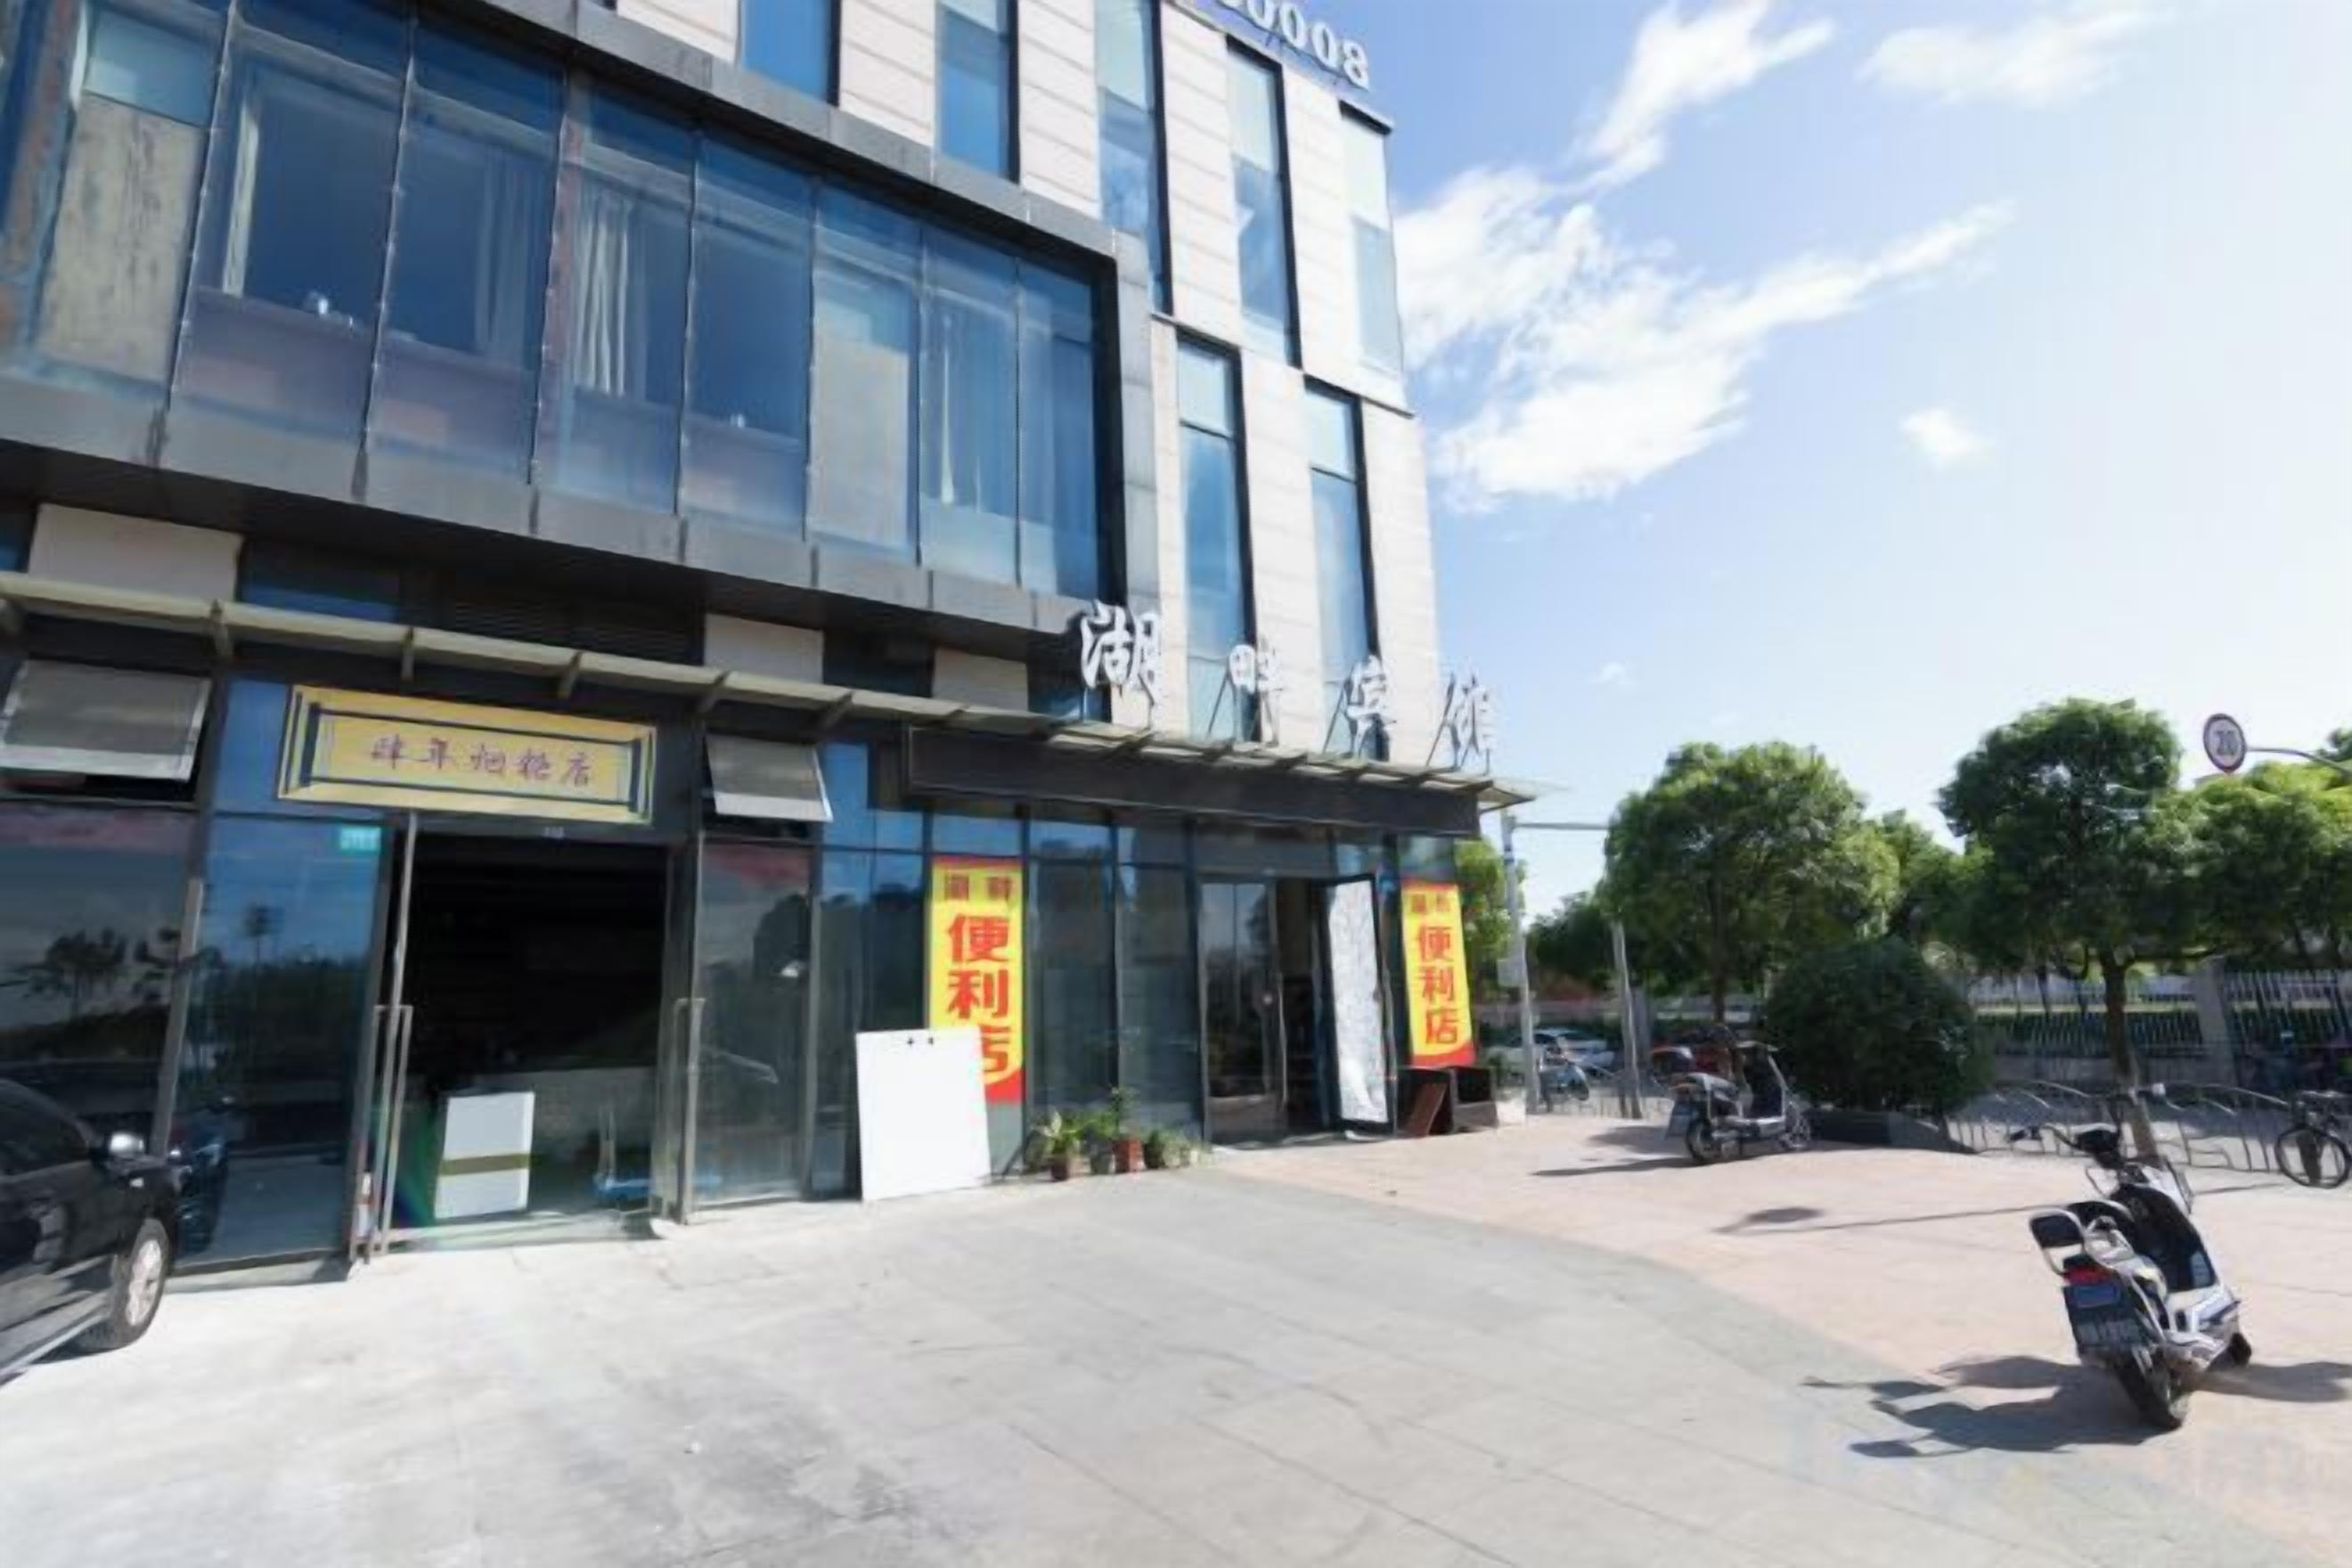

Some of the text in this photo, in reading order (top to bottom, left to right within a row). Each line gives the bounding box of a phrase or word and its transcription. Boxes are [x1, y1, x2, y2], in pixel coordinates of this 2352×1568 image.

[1217, 0, 1370, 88] 0008
[1418, 925, 1458, 1045] 便利店
